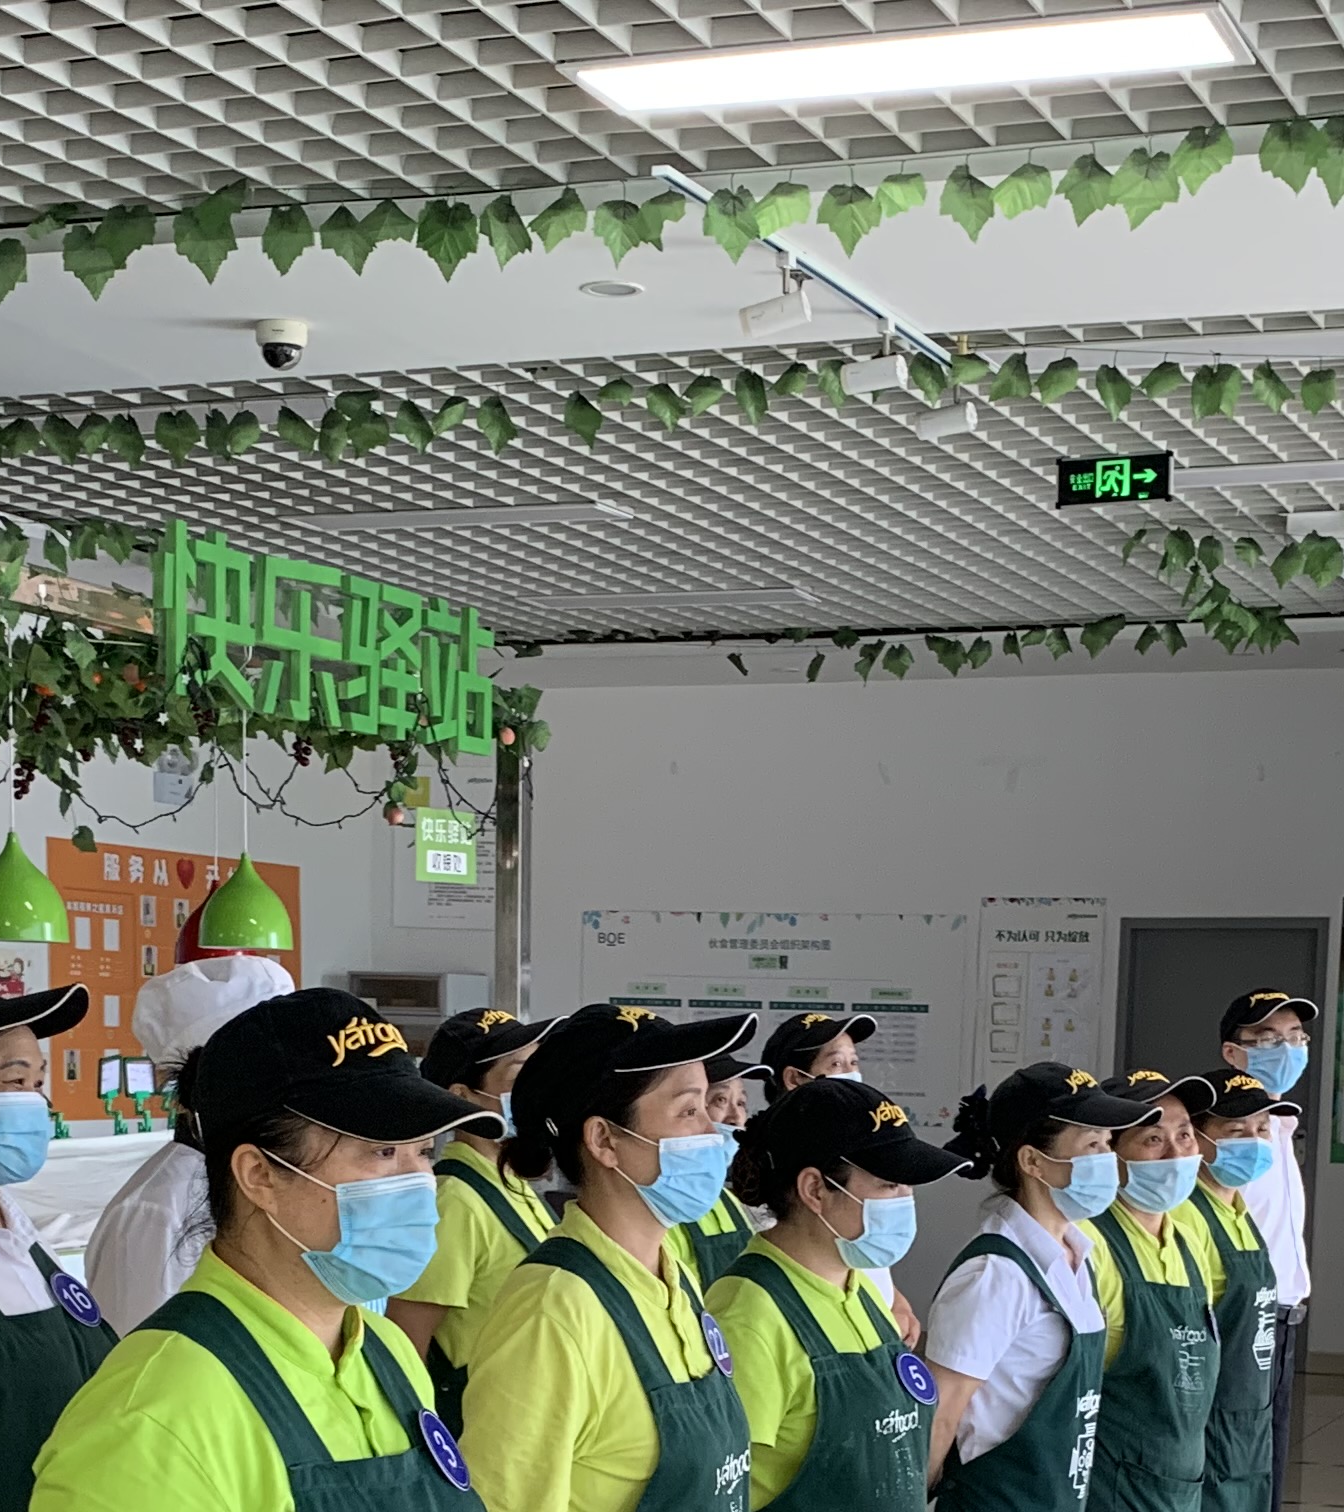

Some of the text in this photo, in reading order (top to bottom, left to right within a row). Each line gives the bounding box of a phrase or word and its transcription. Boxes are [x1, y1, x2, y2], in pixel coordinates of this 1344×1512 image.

[153, 519, 495, 756] 快乐驿站
[421, 816, 473, 846] 快乐驿站
[103, 852, 170, 887] 服务从
[598, 932, 627, 946] BOE
[995, 929, 1041, 943] 不为认可
[61, 1283, 93, 1314] 16
[708, 1327, 730, 1361] 22
[908, 1364, 927, 1391] 5
[433, 1429, 458, 1469] 3
